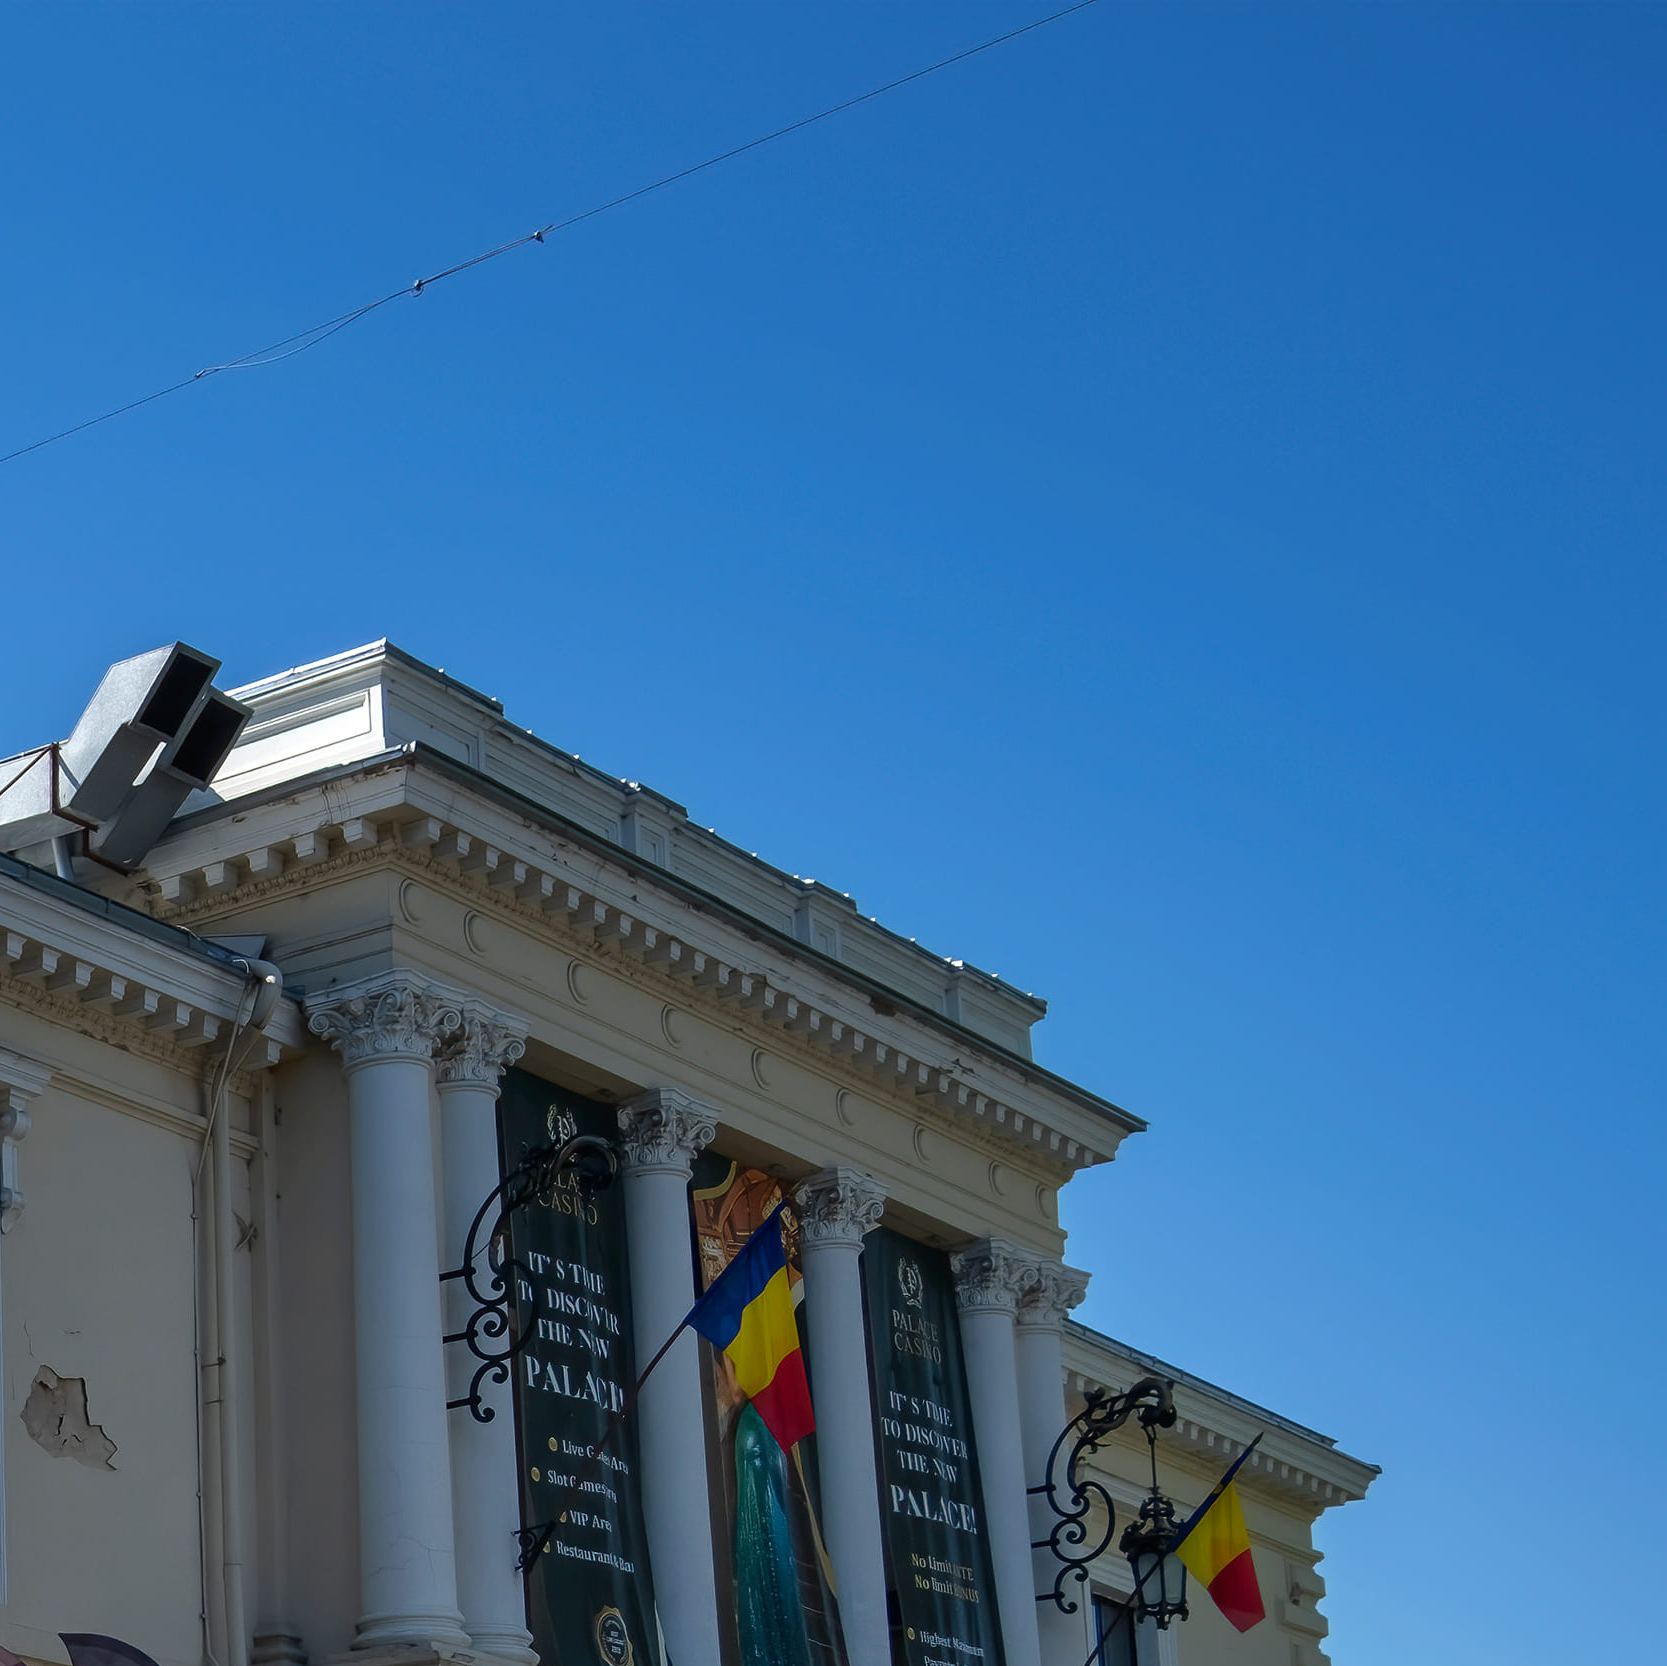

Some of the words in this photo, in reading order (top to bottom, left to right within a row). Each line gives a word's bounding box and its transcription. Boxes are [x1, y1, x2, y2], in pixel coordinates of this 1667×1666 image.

[537, 1317, 573, 1347] THE
[892, 1309, 939, 1342] PALACE
[894, 1331, 942, 1366] CASINO
[562, 1439, 585, 1458] Live
[881, 1416, 901, 1439] TO
[905, 1423, 969, 1461] DISCOVER
[547, 1470, 568, 1488] Slot
[896, 1449, 929, 1474] THE
[933, 1457, 958, 1484] NEW
[570, 1509, 588, 1527] VIP
[890, 1483, 978, 1535] PALACE!
[911, 1552, 926, 1569] No
[928, 1556, 952, 1575] Limit
[914, 1573, 930, 1591] No
